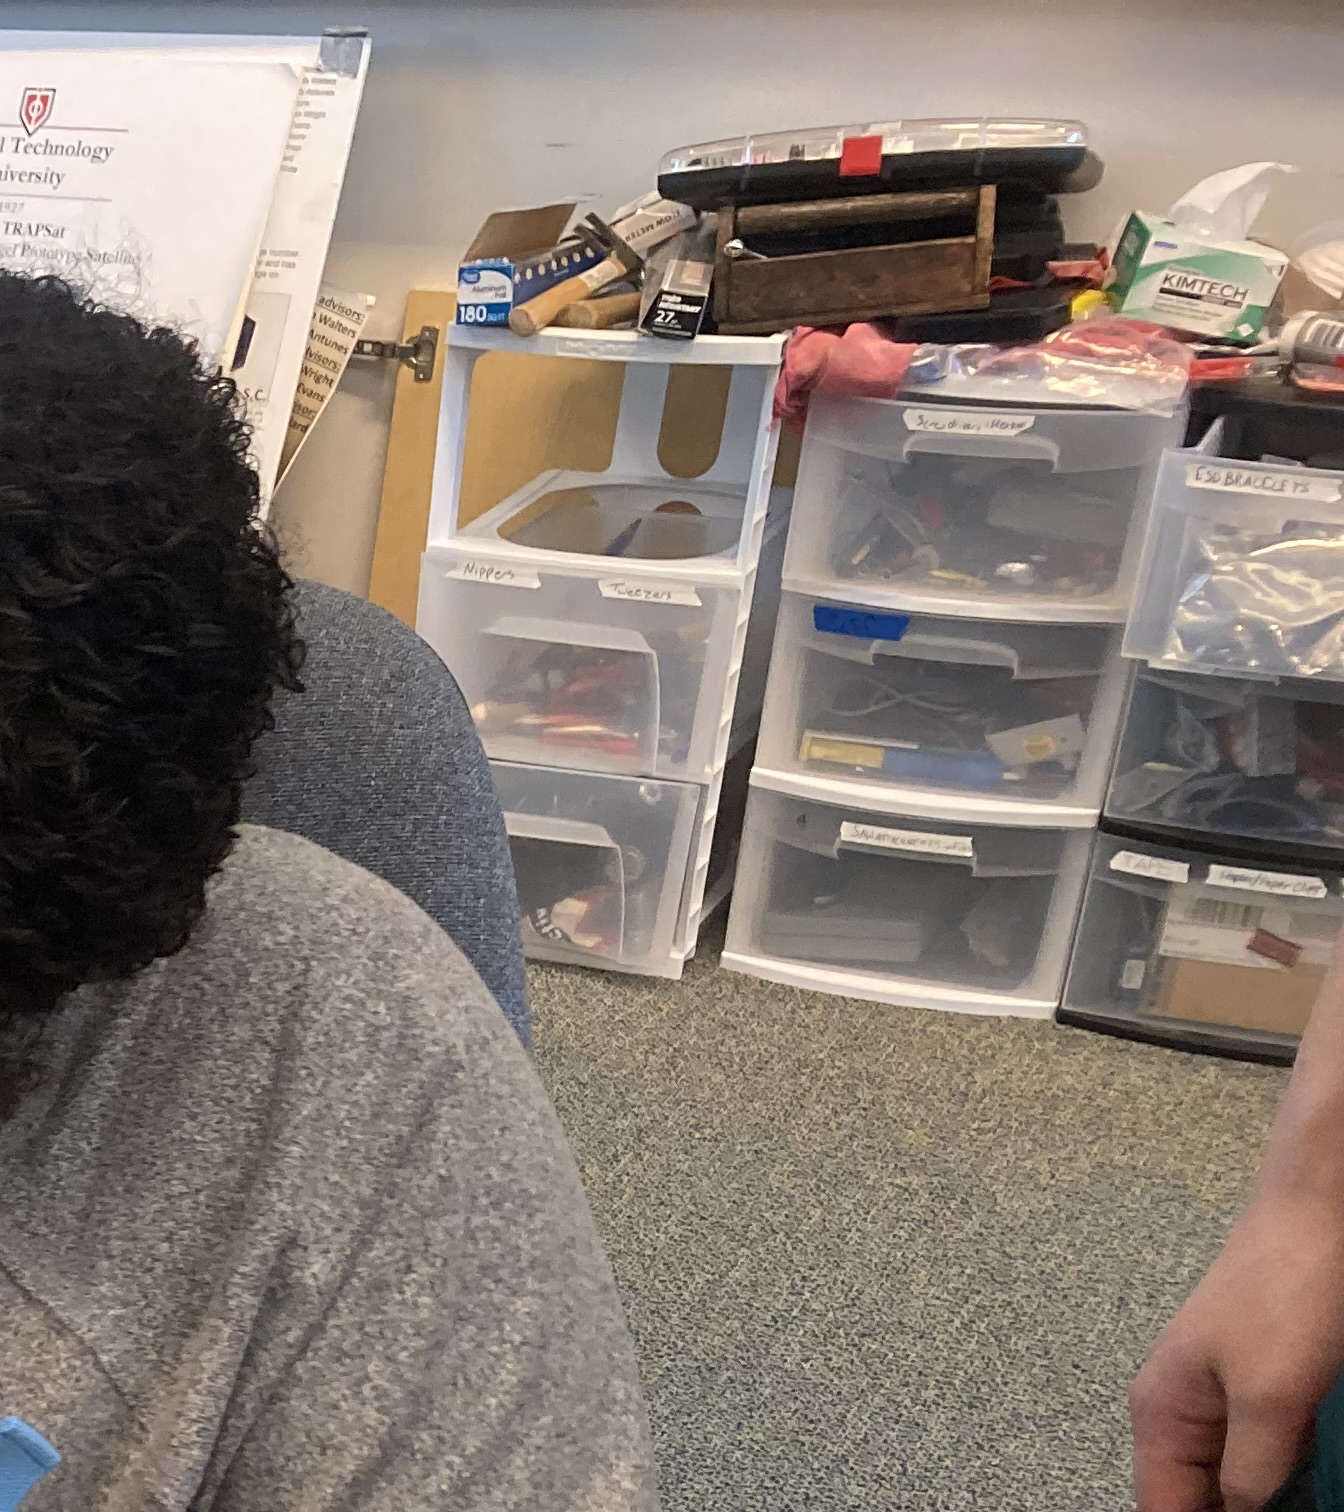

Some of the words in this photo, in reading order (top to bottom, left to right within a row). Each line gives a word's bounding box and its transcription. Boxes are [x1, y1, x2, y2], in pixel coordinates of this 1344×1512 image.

[11, 136, 114, 163] Technology
[3, 220, 66, 239] TRAPSat
[624, 223, 654, 242] METER
[1162, 271, 1250, 301] KIMTECH
[318, 296, 365, 325] advisors:
[459, 305, 487, 323] 180
[654, 309, 675, 323] 27
[318, 312, 358, 339] Walters
